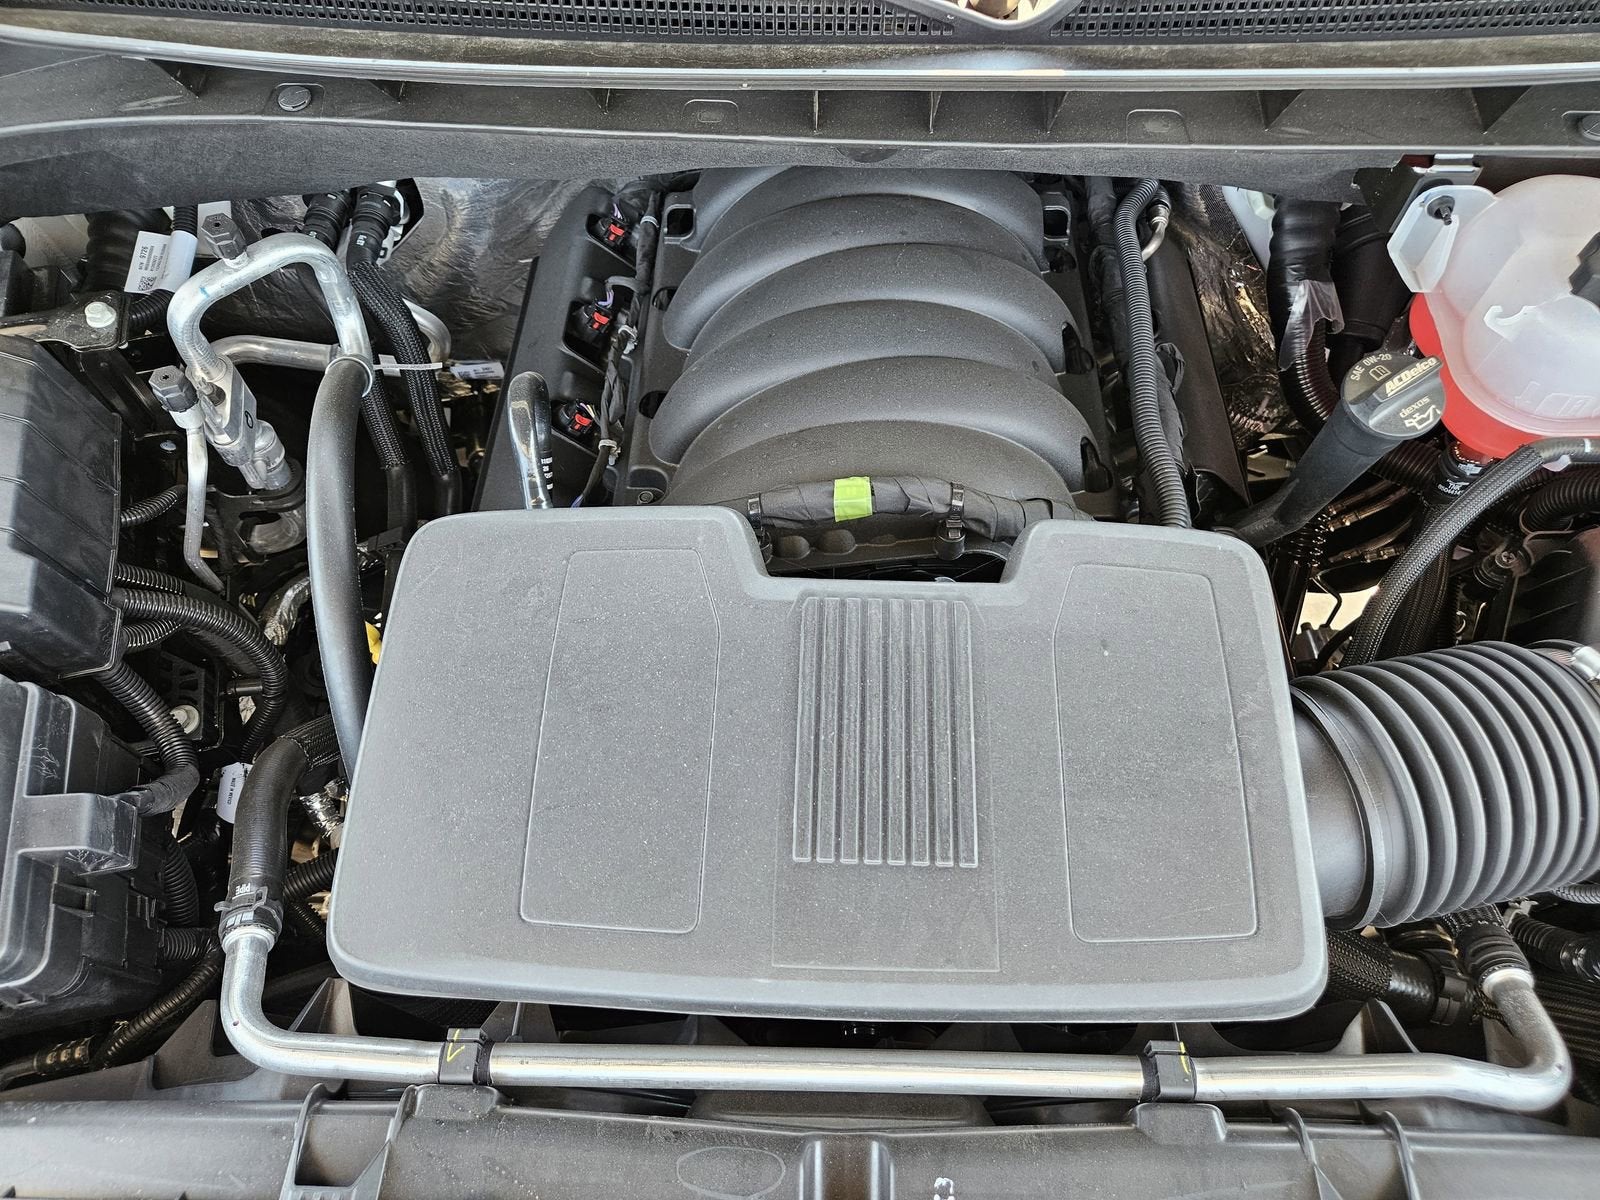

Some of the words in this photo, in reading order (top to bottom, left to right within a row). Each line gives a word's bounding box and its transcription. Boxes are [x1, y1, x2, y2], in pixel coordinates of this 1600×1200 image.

[1350, 365, 1365, 381] SAE
[1363, 353, 1393, 366] 0W-20
[1385, 357, 1438, 395] ACDelco
[1399, 395, 1431, 418] dexos
[235, 882, 251, 896] PIPE
